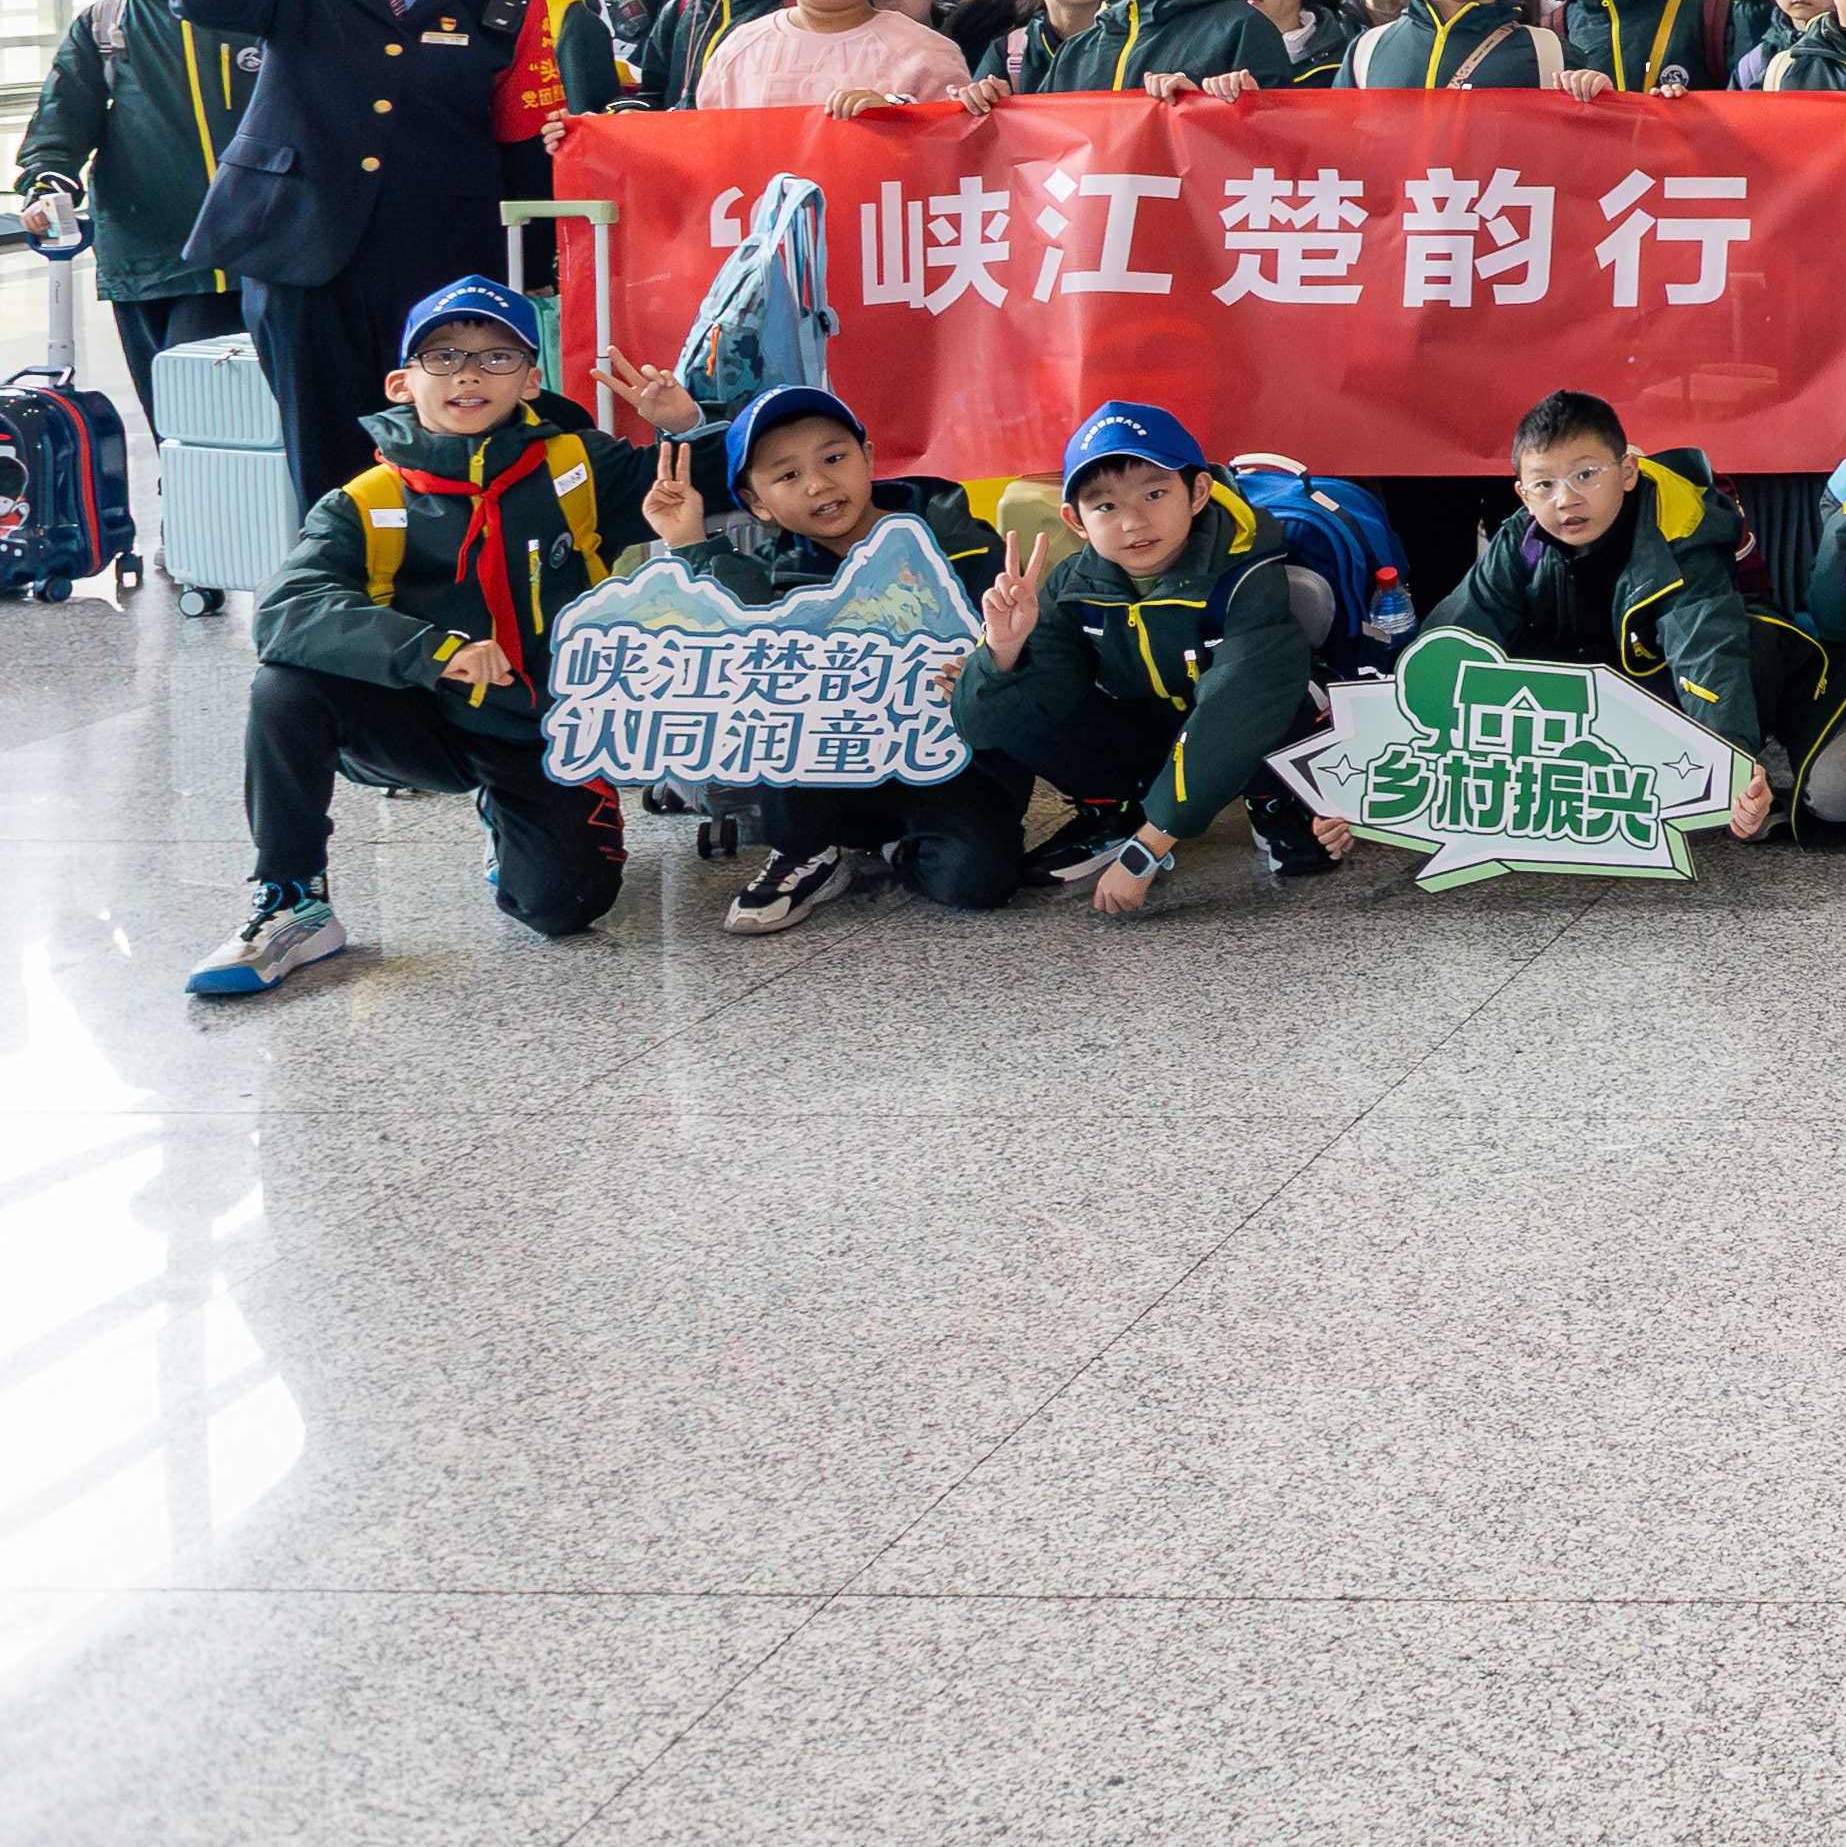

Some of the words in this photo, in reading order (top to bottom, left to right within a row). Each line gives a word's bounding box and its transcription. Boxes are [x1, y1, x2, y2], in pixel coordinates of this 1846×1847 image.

[709, 167, 1751, 315] “峡江楚韵行
[566, 634, 968, 706] 峡江楚韵行
[558, 710, 960, 774] 认同润童心
[1367, 750, 1657, 847] 乡村振兴
